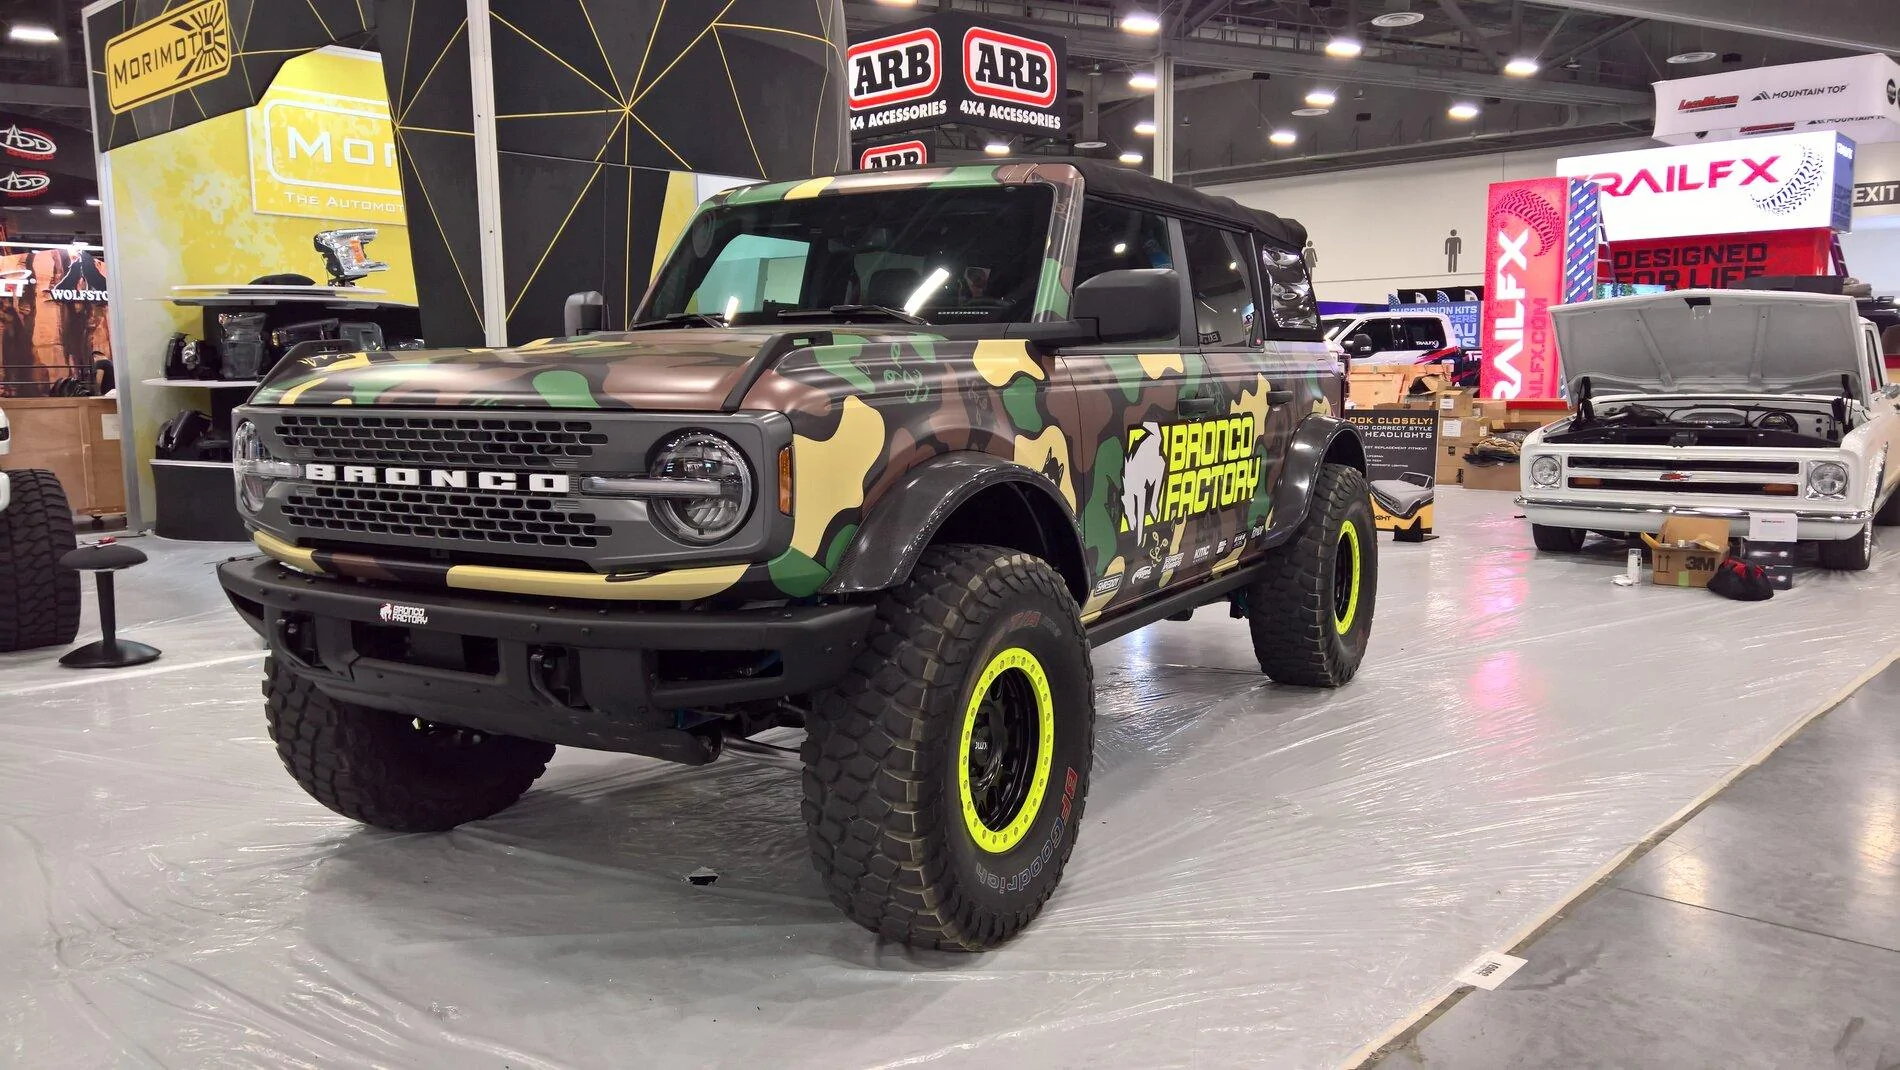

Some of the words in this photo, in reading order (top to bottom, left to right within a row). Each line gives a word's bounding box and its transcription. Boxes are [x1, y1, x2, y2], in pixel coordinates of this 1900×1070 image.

[854, 43, 932, 96] ARB
[975, 42, 1048, 94] ARB
[1772, 87, 1825, 99] MOUNTAIN
[1827, 85, 1847, 94] TOP
[850, 116, 864, 131] X4
[868, 100, 947, 128] ACCESSORIES
[960, 99, 985, 118] 4X4
[989, 104, 1061, 130] ACCESSORIES
[1587, 155, 1782, 197] RAILFX
[284, 191, 320, 205] THE
[327, 196, 406, 213] AUTOMOT
[1853, 184, 1899, 203] EXIT
[1614, 243, 1767, 270] DESIGNED
[51, 289, 108, 301] WOLFSTO
[1450, 314, 1477, 323] CERS
[1455, 306, 1478, 314] KITS
[1491, 228, 1529, 400] RAILFX
[1349, 416, 1374, 424] OOK
[1378, 417, 1433, 425] CLOSELY!
[1169, 416, 1254, 472] BRONCO
[1365, 431, 1433, 439] HEADLIGHTS
[305, 463, 571, 494] BRONCO
[1163, 456, 1261, 522] FACTORY
[1685, 555, 1716, 572] 3M
[392, 605, 425, 617] BRONCO
[392, 613, 428, 625] FACTORY
